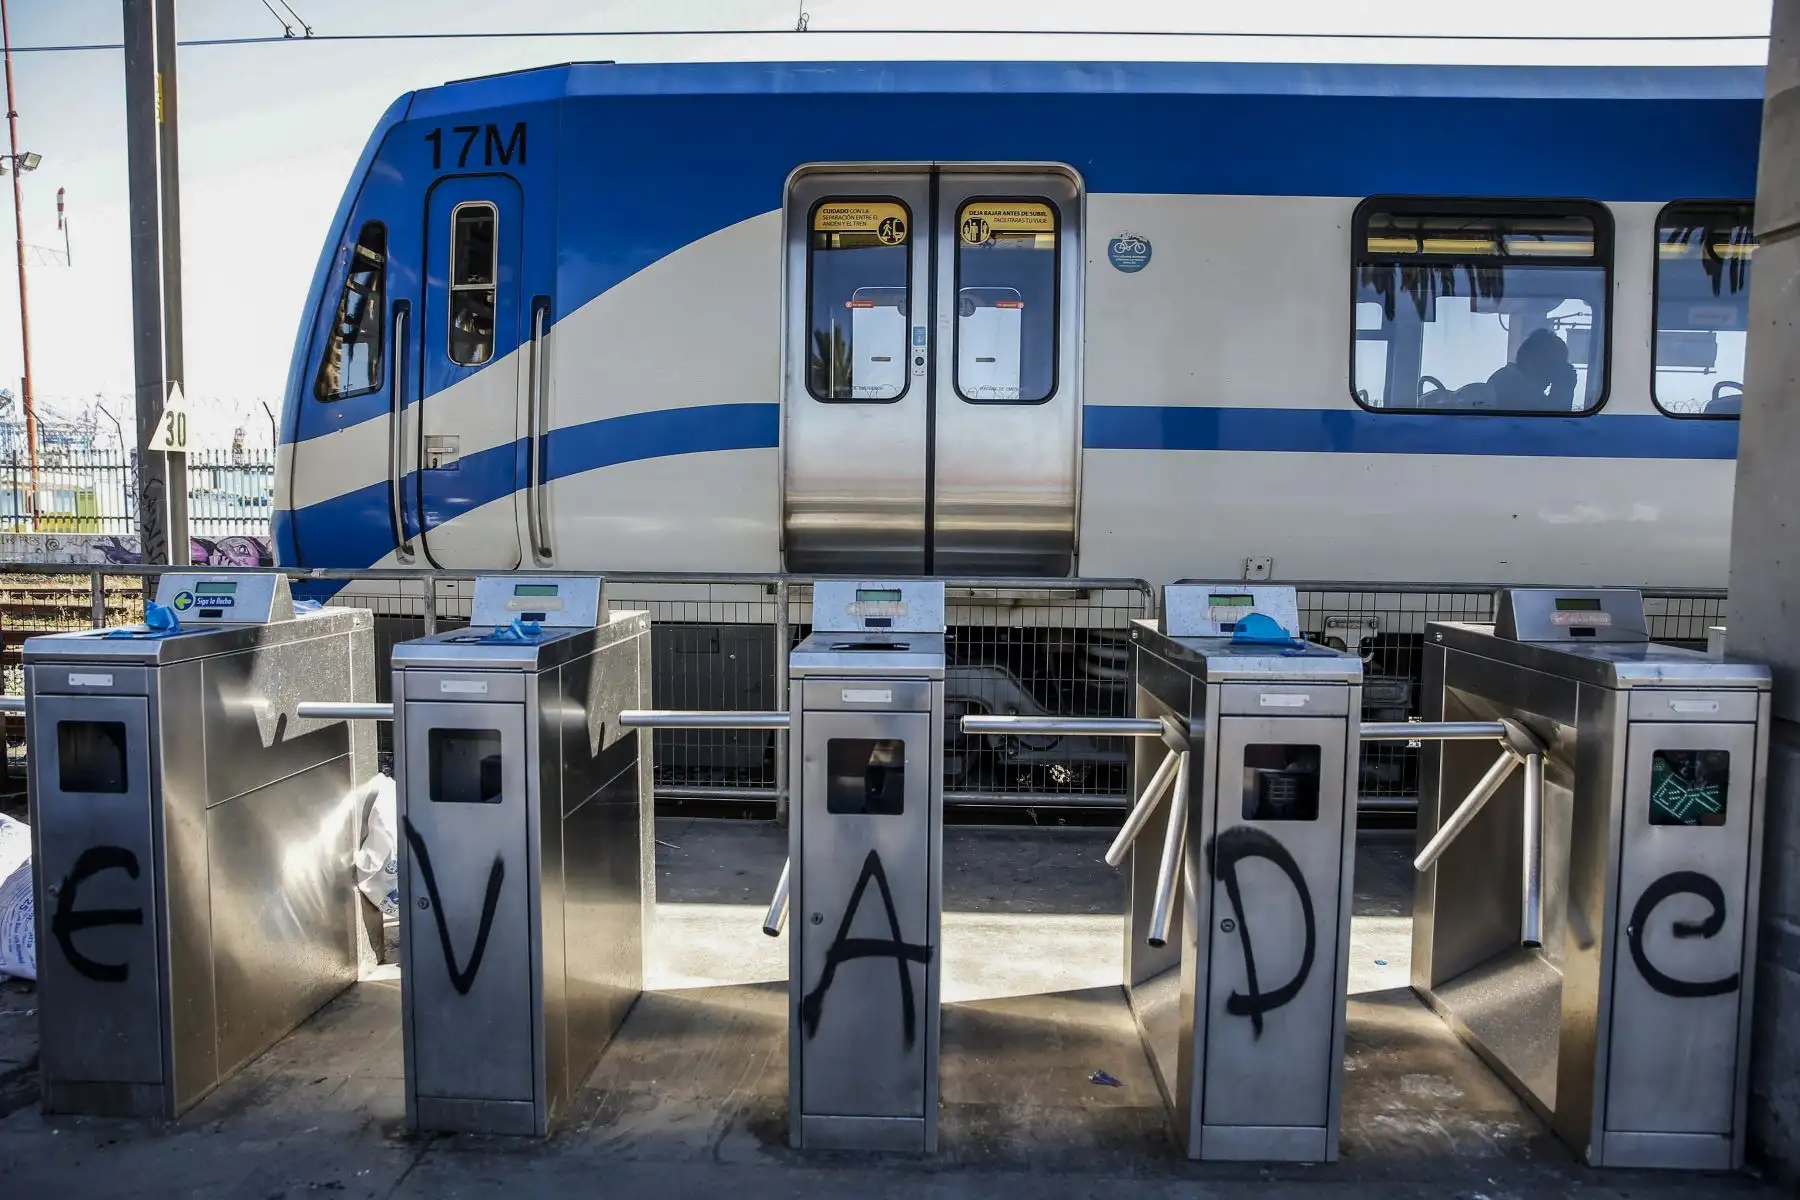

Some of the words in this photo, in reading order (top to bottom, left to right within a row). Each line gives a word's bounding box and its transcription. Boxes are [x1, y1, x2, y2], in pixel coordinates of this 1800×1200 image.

[425, 121, 527, 169] 17M
[165, 410, 187, 447] 30
[197, 597, 209, 606] Siga
[216, 597, 232, 605] flecha
[403, 815, 505, 995] V
[798, 848, 934, 1052] A
[1203, 825, 1316, 1043] D
